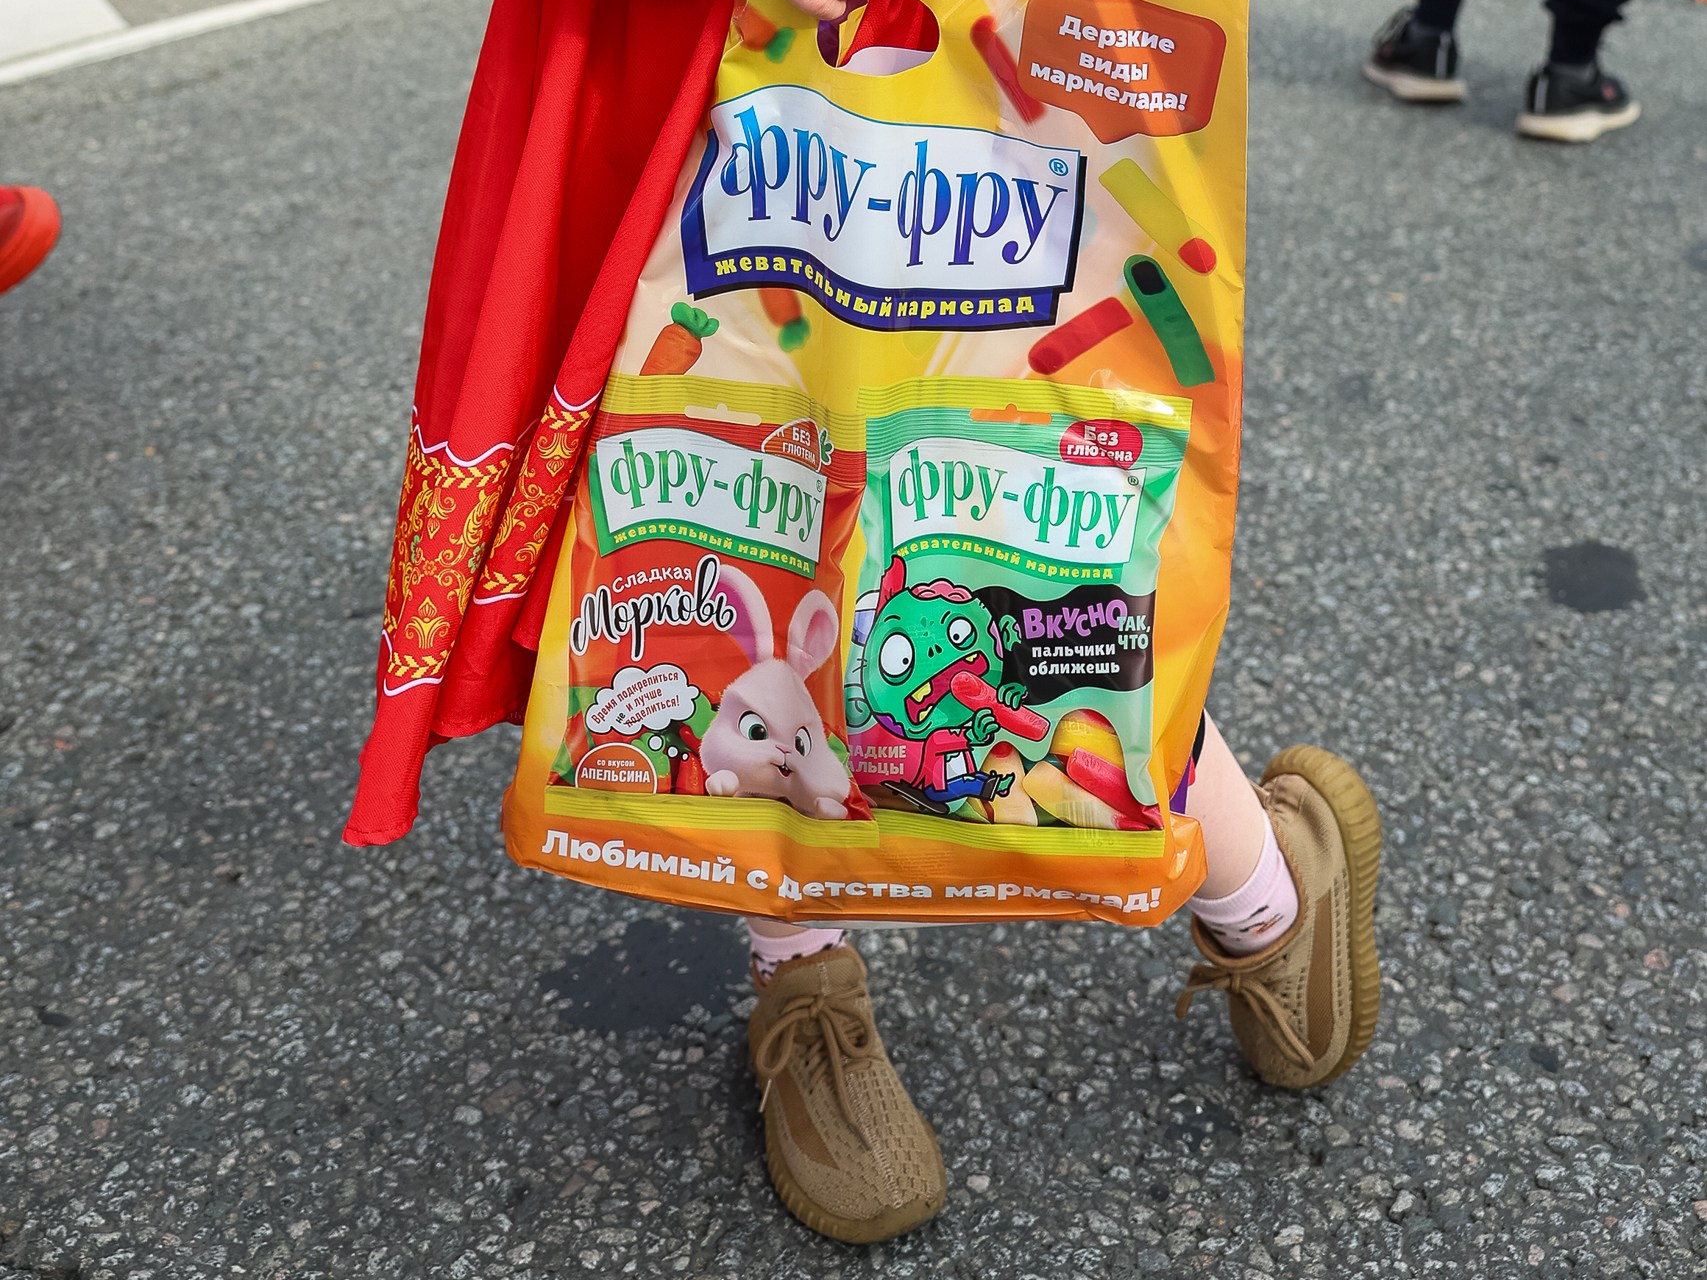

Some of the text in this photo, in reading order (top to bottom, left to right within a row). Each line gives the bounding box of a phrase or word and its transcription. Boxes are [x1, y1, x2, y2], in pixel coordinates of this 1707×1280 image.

[1058, 14, 1176, 54] Дерзкие
[1079, 52, 1149, 83] виды
[1030, 62, 1189, 113] мармелада!
[714, 254, 892, 318] жевательный
[792, 426, 811, 447] БЕЗ
[1084, 424, 1119, 446] Без
[782, 441, 816, 465] ГЛЮТЕНА
[1066, 444, 1134, 462] глютена
[614, 523, 811, 574] жевательный мармелад
[897, 539, 1114, 580] жевательный мармелад
[572, 556, 735, 659] Морковь
[1117, 615, 1151, 633] ТАК,
[1031, 643, 1116, 658] пальчики
[1117, 634, 1149, 650] ЧТО
[1028, 660, 1121, 676] оближешь
[591, 672, 679, 725] Время подкрепиться
[625, 688, 663, 712] и лучше
[581, 767, 651, 783] АПЕЛЬСИНА
[607, 759, 635, 768] вкусом
[848, 761, 904, 776] АЛЬЦЫ
[542, 829, 736, 885] Любимый
[746, 869, 769, 890] с
[945, 881, 1161, 914] мармелад!
